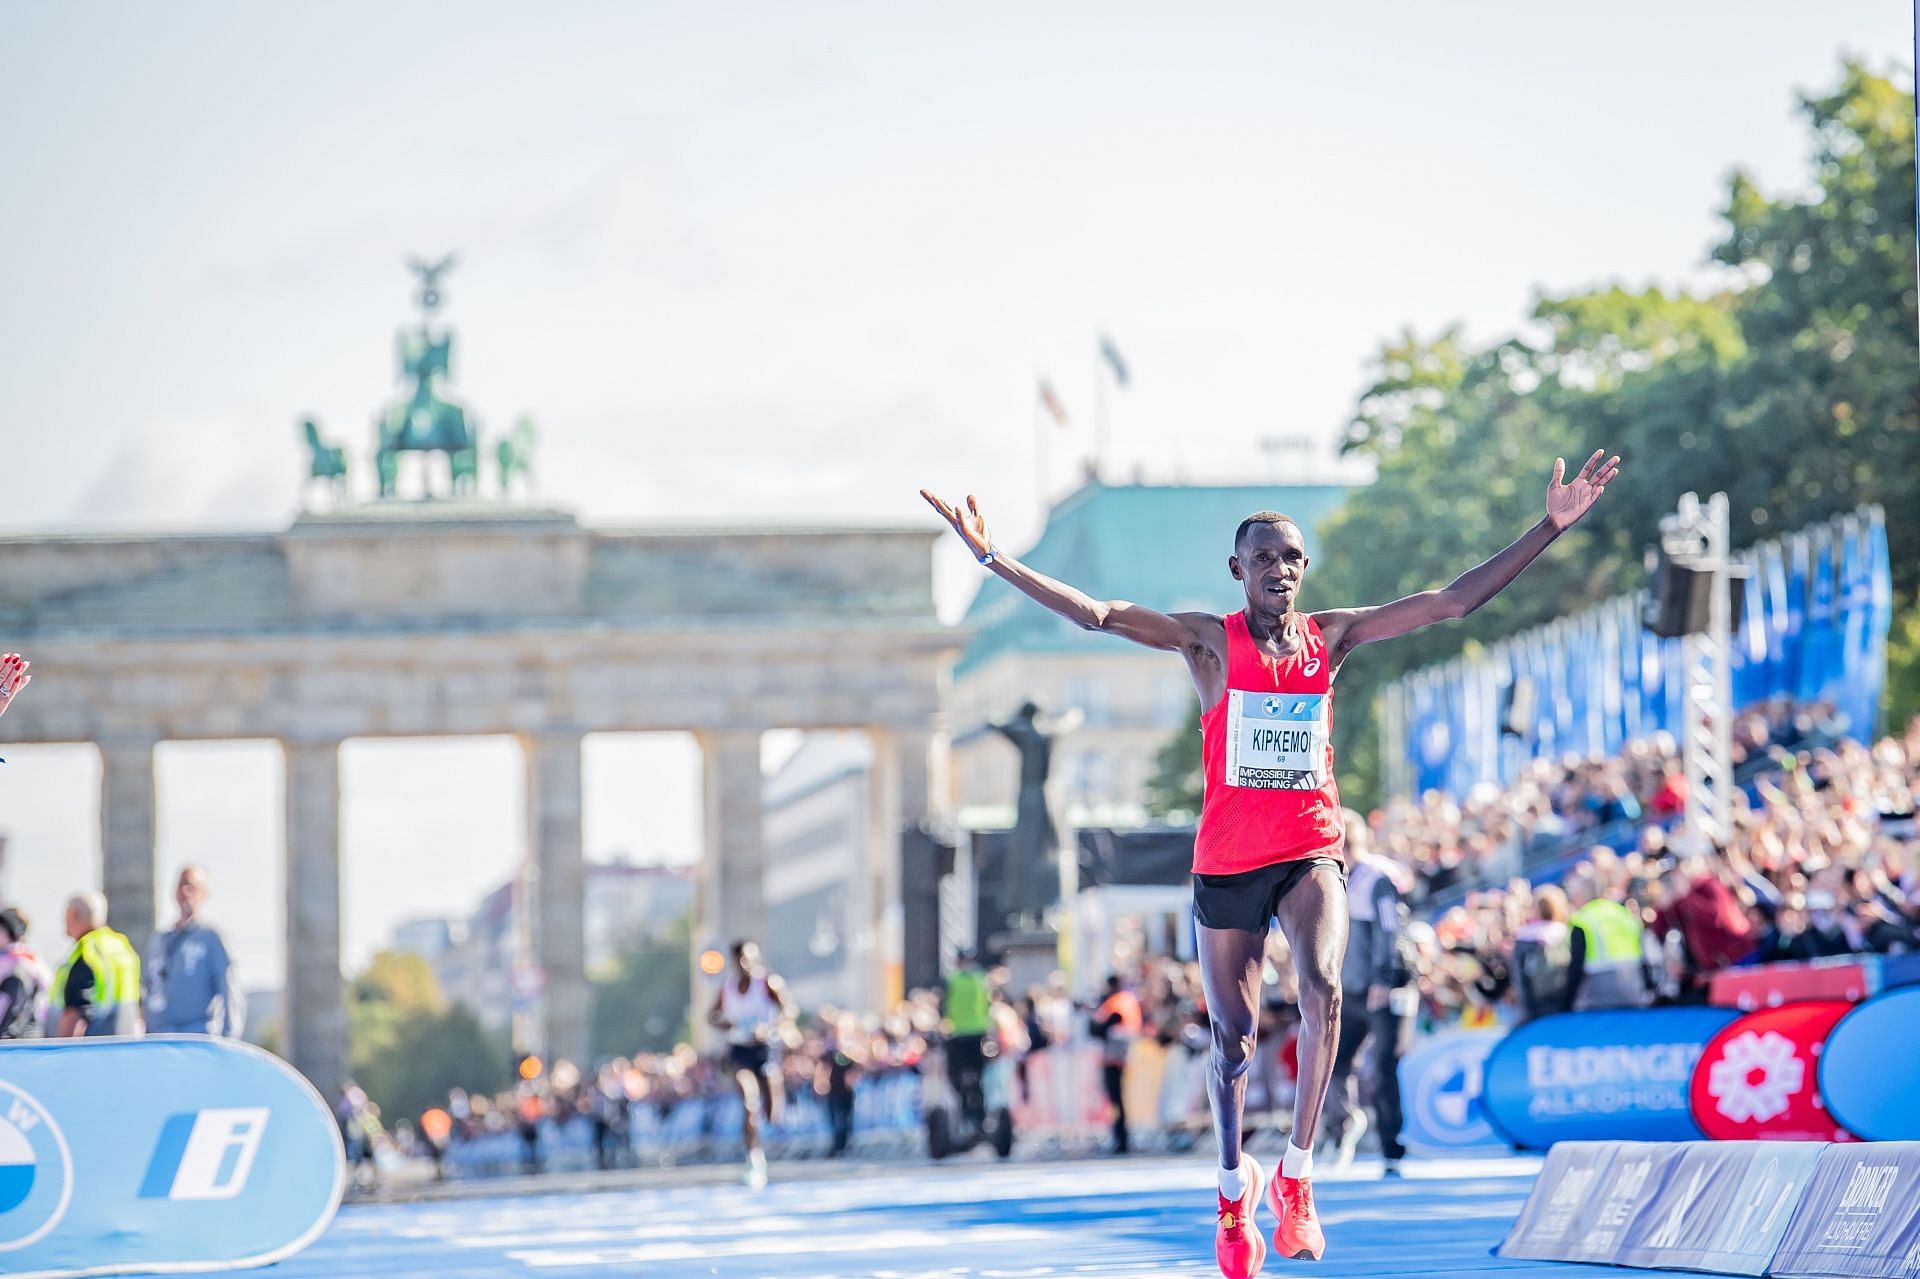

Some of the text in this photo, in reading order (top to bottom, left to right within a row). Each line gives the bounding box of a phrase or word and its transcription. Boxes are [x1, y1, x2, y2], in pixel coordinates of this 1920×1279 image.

[1277, 755, 1286, 763] 69
[1240, 767, 1294, 779] IMPOSSIBLE
[1239, 777, 1291, 789] IS NOTHING
[1838, 1161, 1899, 1214] ERDINGER
